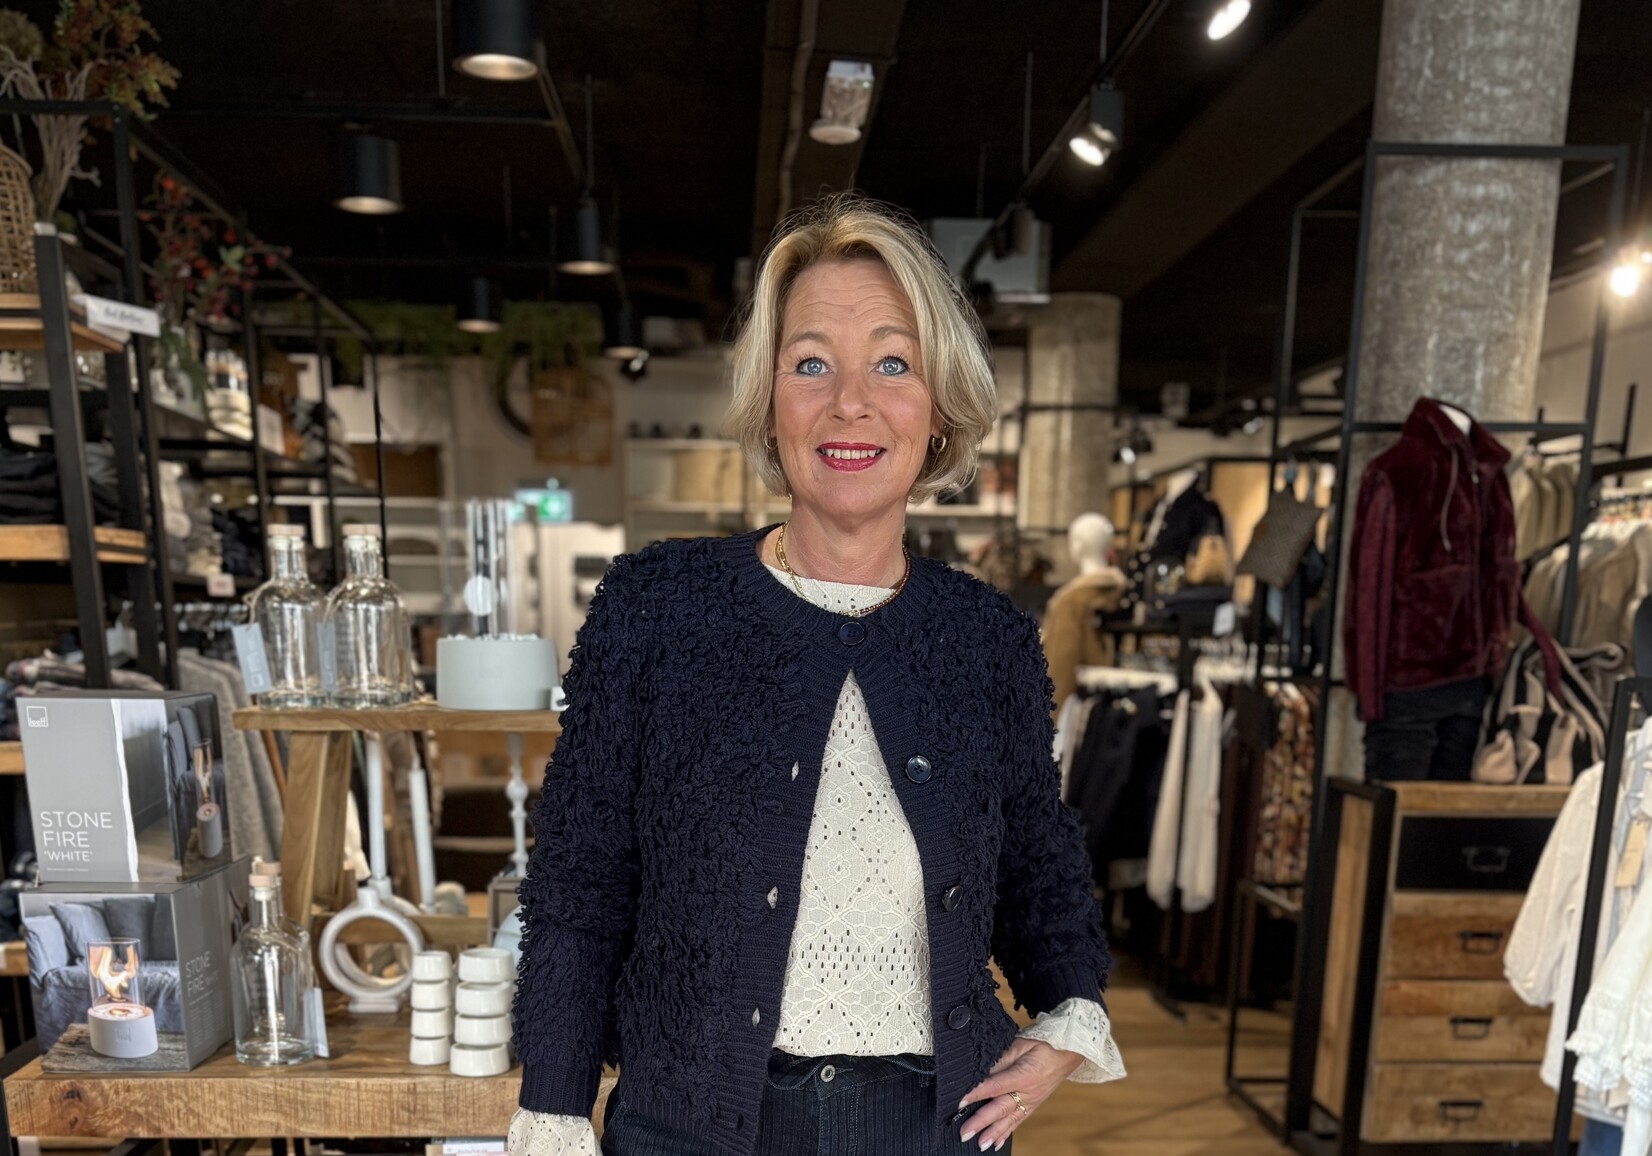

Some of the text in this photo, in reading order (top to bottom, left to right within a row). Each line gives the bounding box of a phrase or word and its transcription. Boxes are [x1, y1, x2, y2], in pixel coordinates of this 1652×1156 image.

[40, 811, 113, 829] STONE
[43, 831, 90, 848] FIRE
[185, 950, 211, 978] STONE
[187, 974, 205, 998] FIRE
